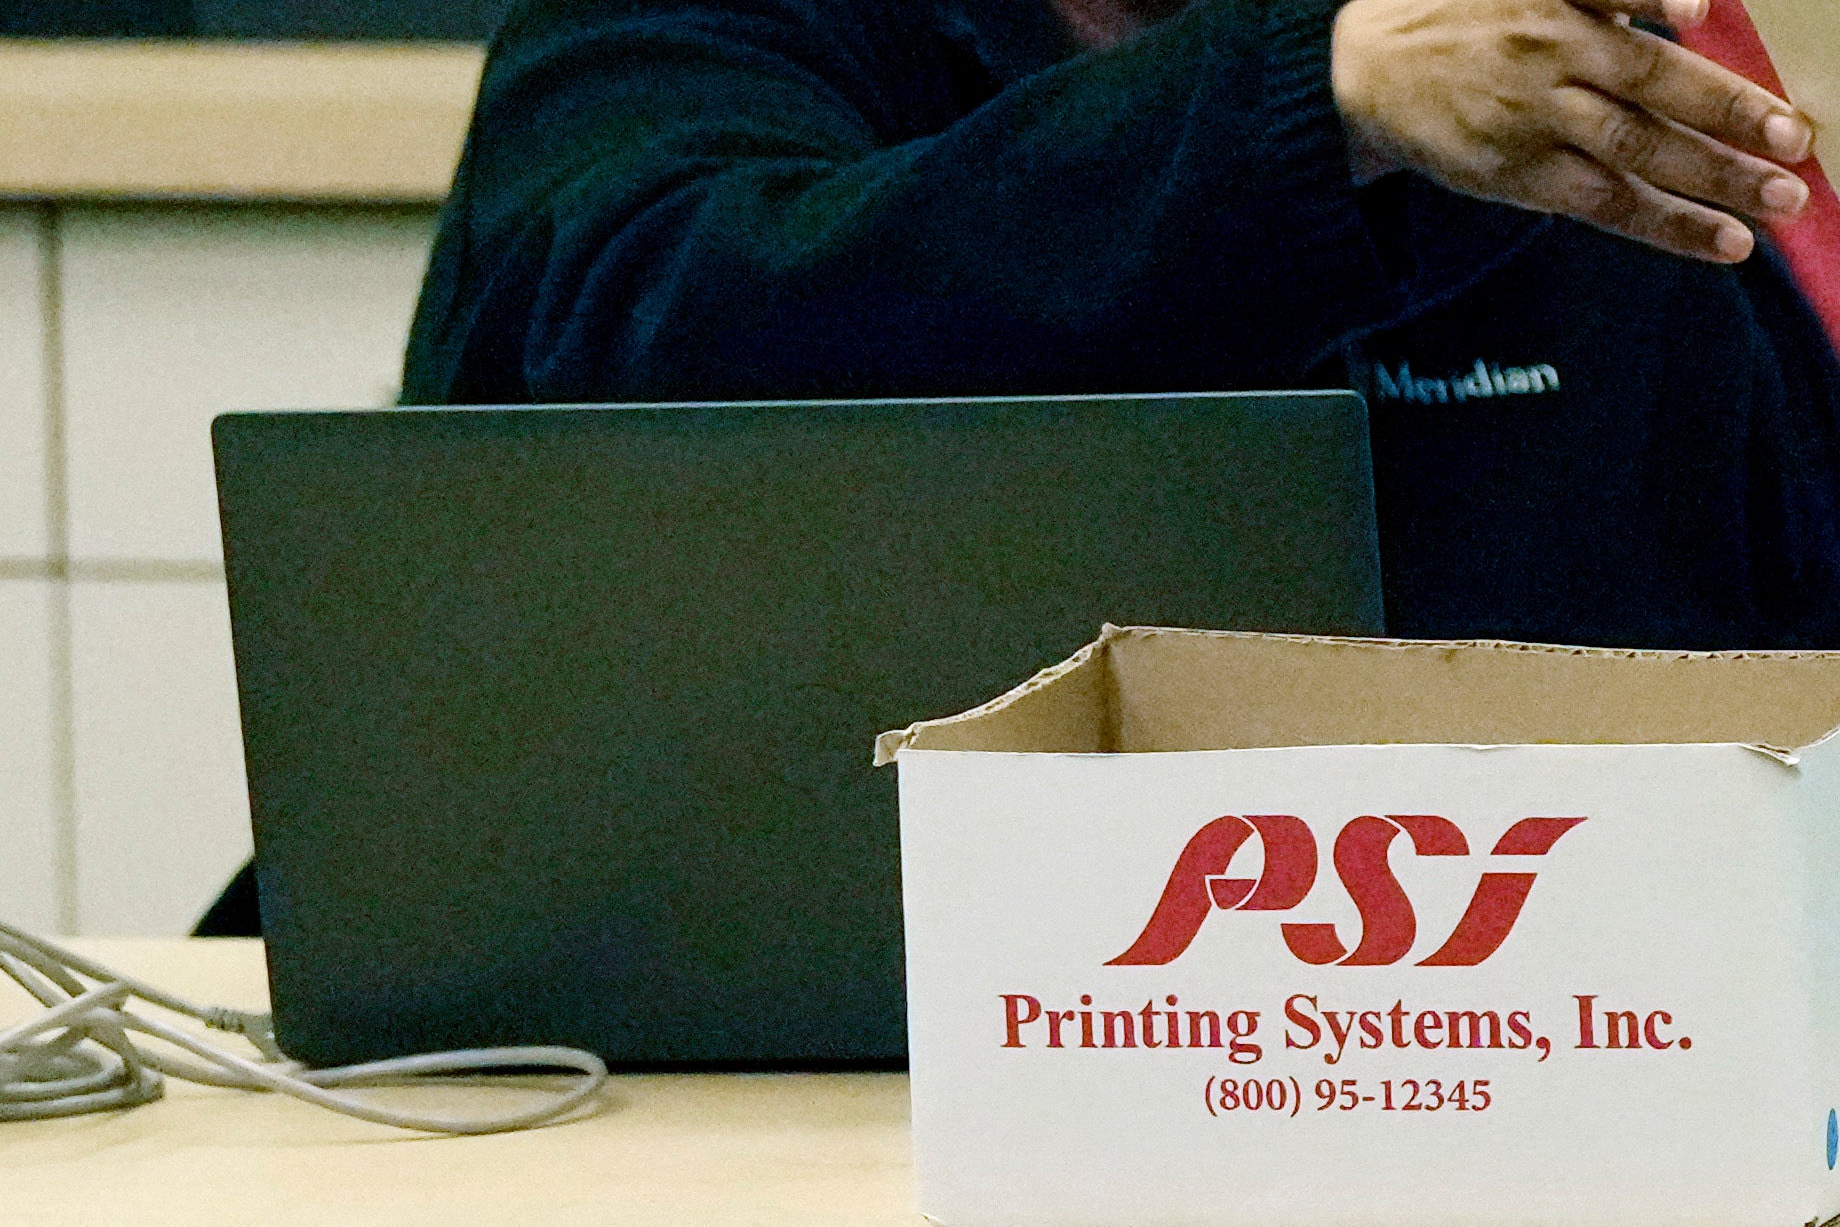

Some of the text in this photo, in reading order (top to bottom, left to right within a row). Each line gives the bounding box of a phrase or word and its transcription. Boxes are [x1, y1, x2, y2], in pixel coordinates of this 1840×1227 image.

[1001, 994, 1693, 1064] Printing Systems, Inc.
[1204, 1076, 1493, 1116] (800) 95-12345
